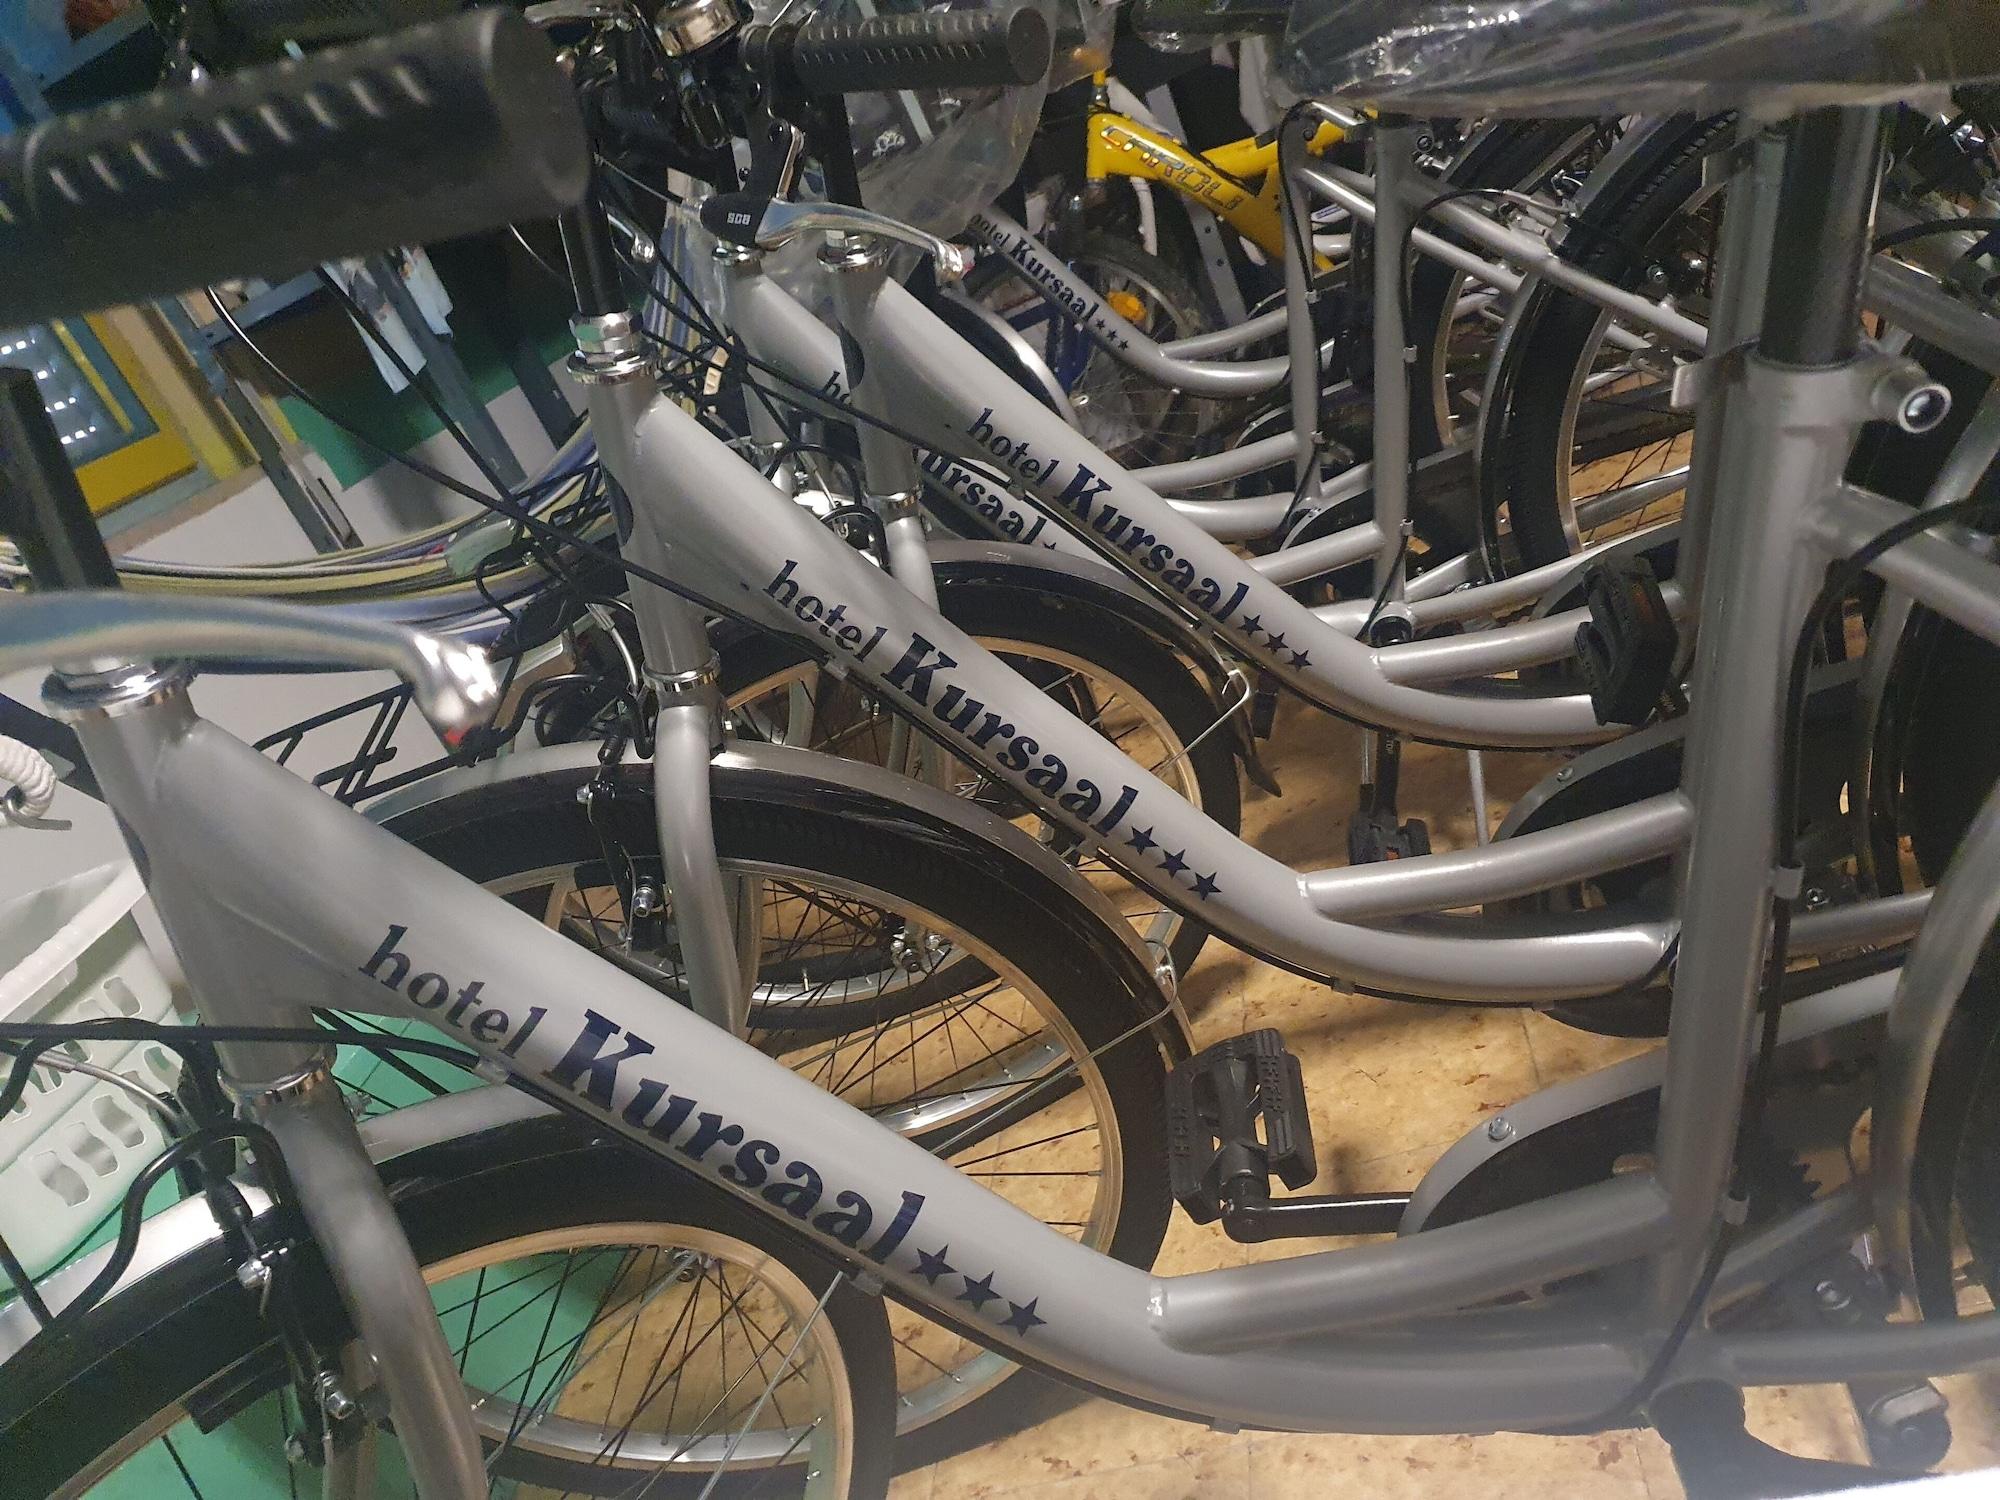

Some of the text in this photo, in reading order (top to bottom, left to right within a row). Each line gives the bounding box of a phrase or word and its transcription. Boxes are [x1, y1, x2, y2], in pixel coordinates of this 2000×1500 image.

[1010, 236, 1100, 322] Kursaal
[912, 447, 1048, 544] ursaal
[966, 407, 1250, 624] hotel Kursaal
[763, 560, 1139, 838] hotel Kursaal
[358, 924, 926, 1263] hotel Kursaal
